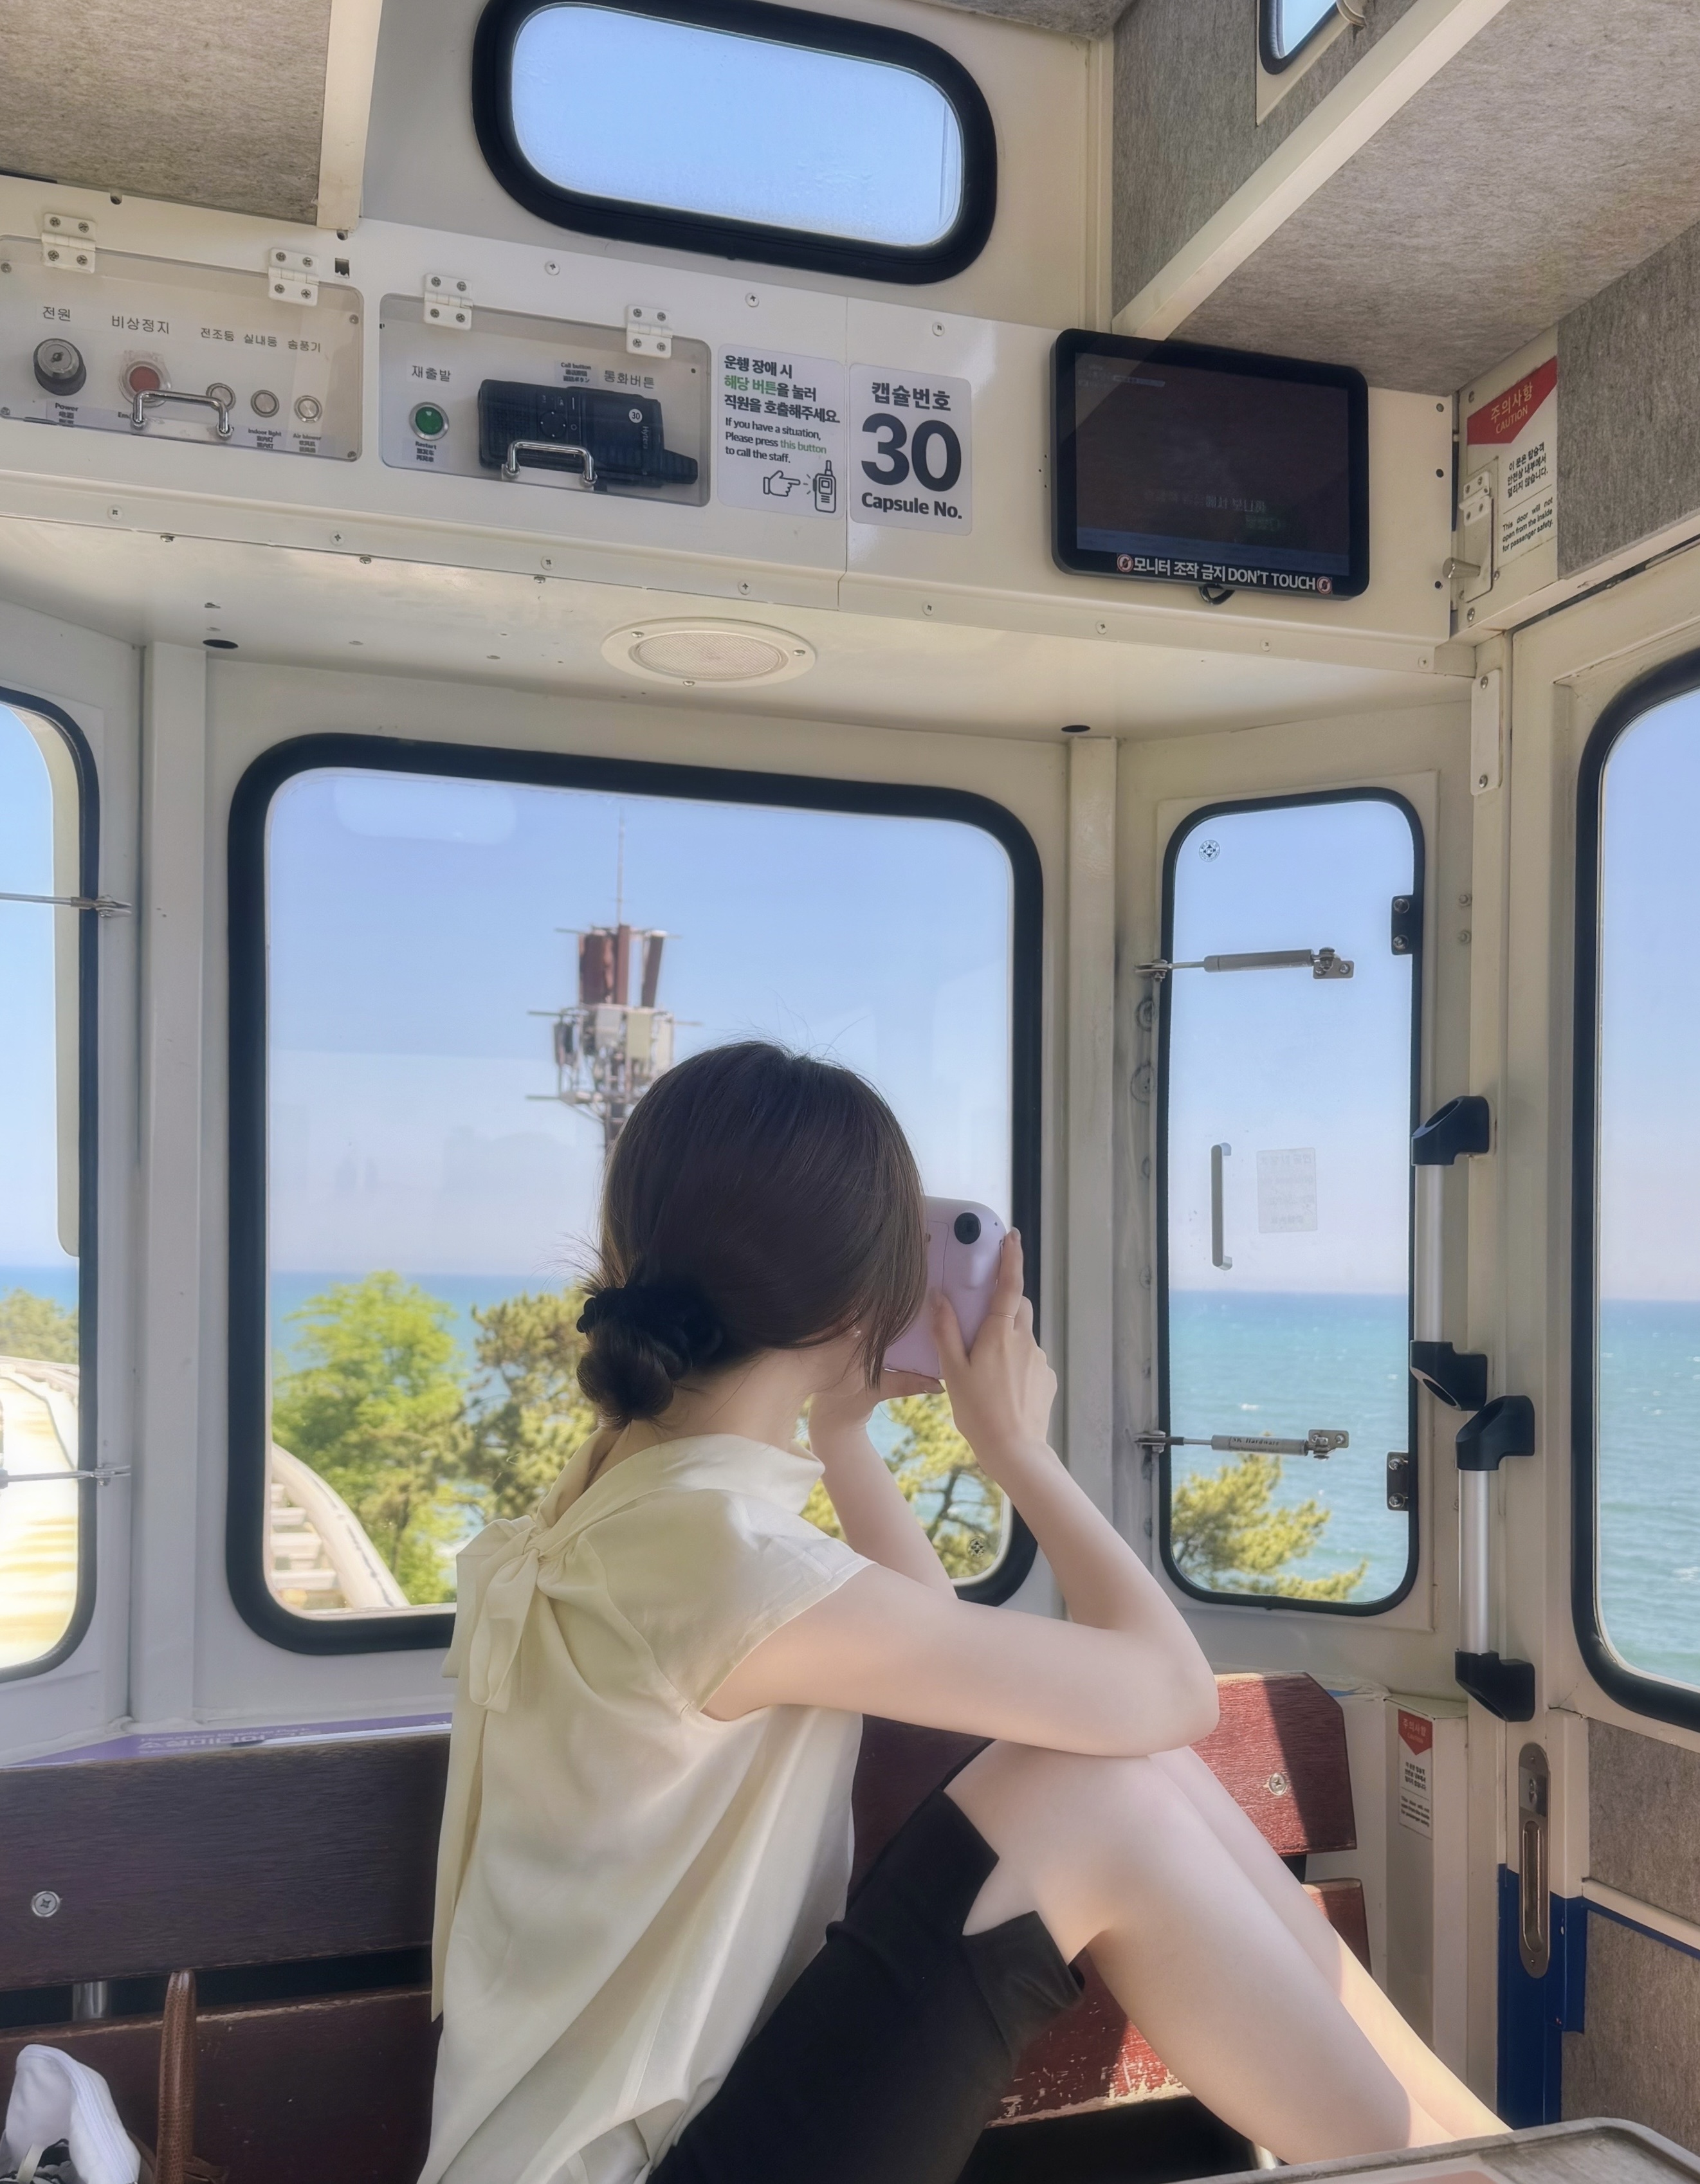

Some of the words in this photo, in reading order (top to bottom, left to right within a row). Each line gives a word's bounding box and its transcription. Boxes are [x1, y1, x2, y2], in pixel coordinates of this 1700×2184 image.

[42, 306, 71, 322] 전원
[112, 315, 169, 334] 비상정지
[201, 327, 234, 341] 전조등
[244, 334, 277, 347] 실내등
[288, 340, 321, 353] 송풍기
[412, 365, 452, 382] 재출발
[724, 355, 749, 372] 운행
[752, 359, 777, 376] 장애
[780, 364, 792, 379] 시
[604, 370, 655, 389] 통화버튼
[724, 375, 749, 392] 해당
[753, 379, 790, 397] 버튼을
[792, 385, 816, 402] 눌러
[872, 382, 951, 411] 캡슐번호
[1491, 381, 1533, 424] 주의사항
[55, 403, 79, 412] Power
[632, 412, 640, 420] 30
[724, 394, 762, 413] 직원을
[764, 400, 840, 423] 호출해주세요.
[726, 417, 731, 426] If
[734, 420, 750, 428] you
[752, 421, 773, 432] have
[782, 426, 821, 441] situation,
[1496, 405, 1528, 434] CAUTION
[726, 432, 754, 444] Please
[755, 437, 778, 447] press
[780, 440, 796, 450] this
[798, 442, 827, 454] button
[861, 413, 962, 492] 30
[726, 446, 735, 455] to
[736, 448, 751, 457] call
[753, 449, 767, 460] the
[769, 453, 791, 463] staff.
[1509, 460, 1514, 471] 이
[861, 492, 929, 514] Capsule
[934, 501, 962, 519] No.
[1503, 522, 1513, 531] This
[1517, 512, 1528, 523] door
[1133, 558, 1171, 576] 모니터
[1173, 561, 1198, 578] 조작
[1201, 563, 1225, 581] 금지
[1228, 567, 1268, 585] DON'T
[1271, 572, 1315, 590] TOUCH
